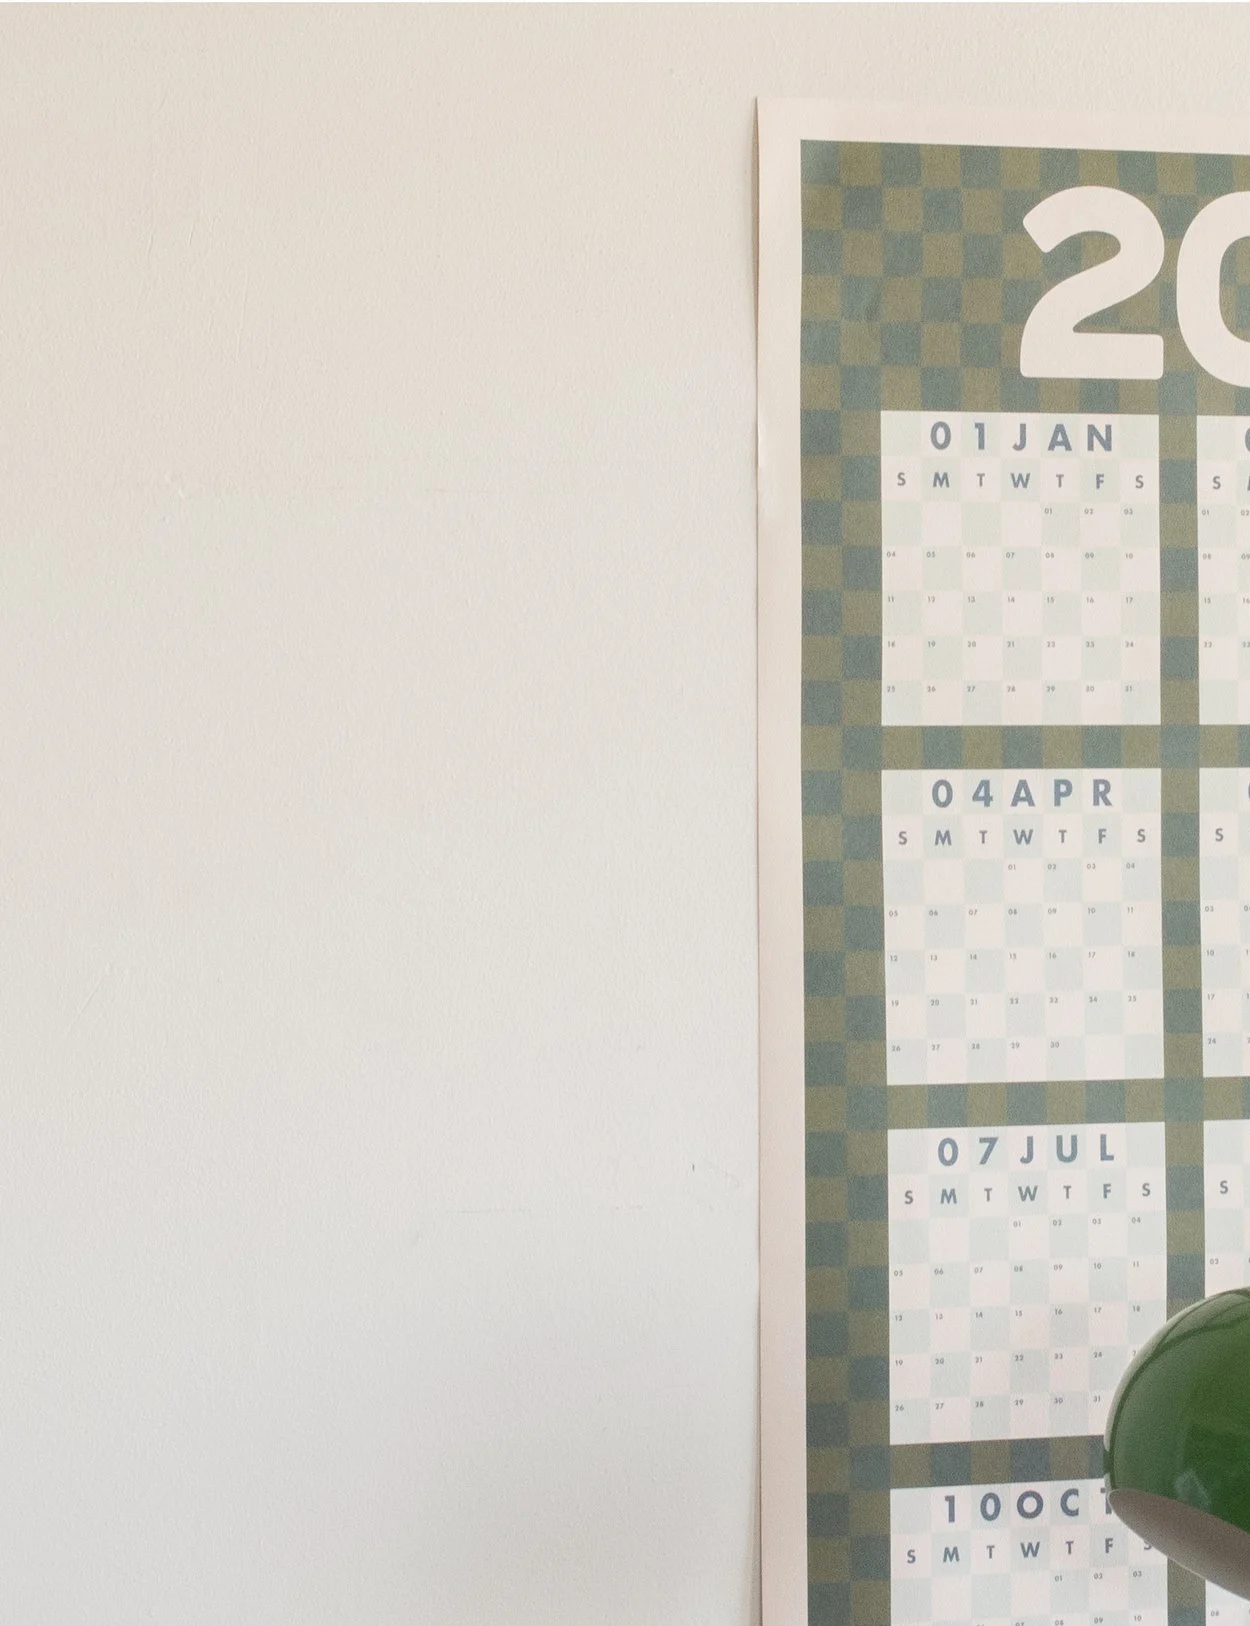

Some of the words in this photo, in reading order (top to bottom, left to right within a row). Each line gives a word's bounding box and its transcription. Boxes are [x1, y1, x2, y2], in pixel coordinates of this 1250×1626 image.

[896, 471, 907, 487] S
[932, 470, 951, 489] M
[975, 472, 986, 488] T
[1009, 471, 1032, 490] W
[1055, 473, 1065, 489] T
[1095, 472, 1105, 491] F
[1134, 474, 1145, 490] S
[1212, 475, 1222, 491] S
[898, 830, 908, 846] S
[933, 828, 953, 847] M
[978, 829, 989, 845] T
[1012, 828, 1034, 846] W
[1057, 828, 1068, 845] T
[1097, 827, 1108, 845] F
[1136, 827, 1147, 844] S
[1214, 827, 1225, 843] S
[903, 1189, 915, 1206] S
[939, 1187, 958, 1205] M
[983, 1187, 994, 1203] T
[1017, 1184, 1039, 1203] W
[1062, 1184, 1073, 1200] T
[1102, 1182, 1113, 1200] F
[1141, 1182, 1151, 1198] S
[1219, 1179, 1229, 1195] S
[906, 1548, 917, 1565] S
[942, 1545, 961, 1564] M
[985, 1544, 996, 1560] T
[1019, 1540, 1041, 1561] W
[1064, 1539, 1075, 1556] T
[1104, 1536, 1115, 1555] F
